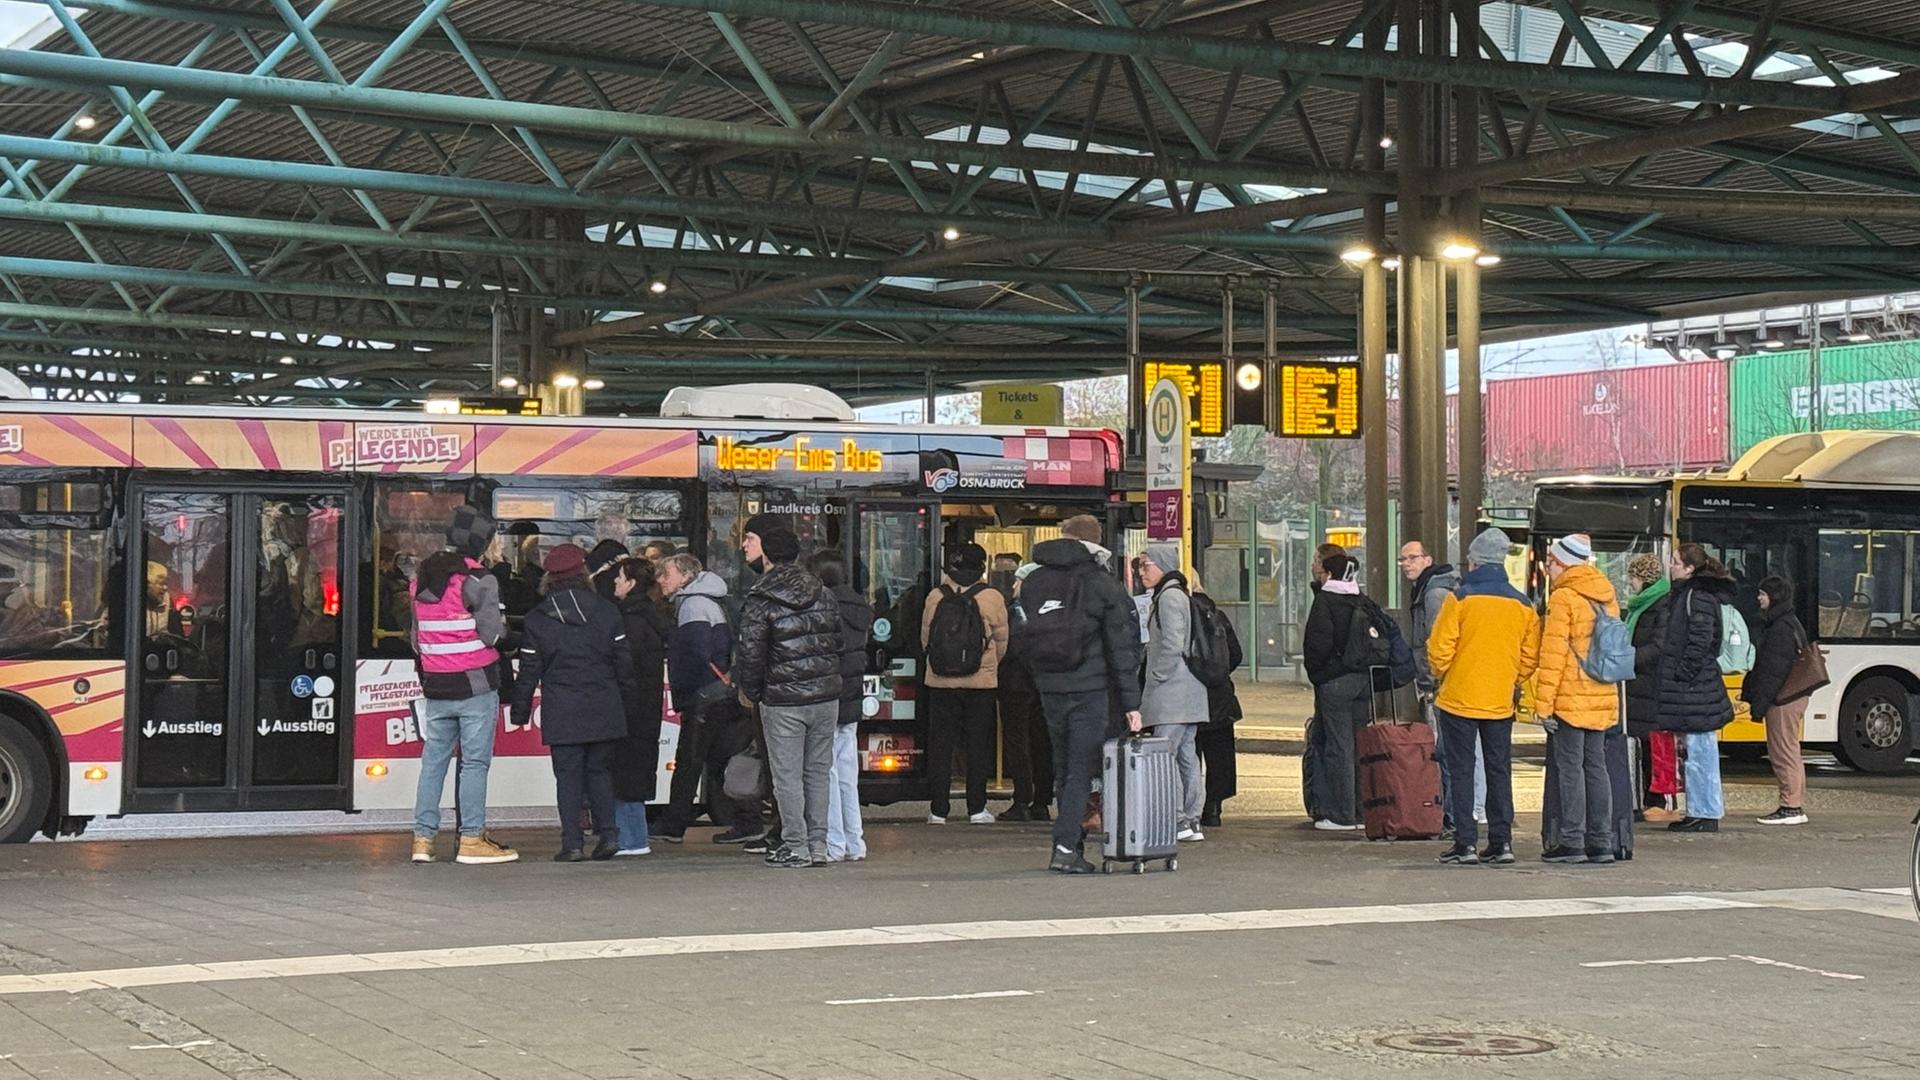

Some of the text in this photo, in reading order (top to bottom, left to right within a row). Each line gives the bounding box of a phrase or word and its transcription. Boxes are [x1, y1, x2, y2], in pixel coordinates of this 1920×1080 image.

[998, 391, 1039, 402] Tickets
[1013, 408, 1024, 420] &
[358, 428, 399, 441] WERDE
[716, 435, 883, 472] Weser-Ems Bus
[1033, 461, 1071, 471] MAN
[763, 502, 847, 515] Landkreis Osn
[1703, 498, 1730, 507] MAN
[158, 720, 222, 736] Ausstieg
[272, 719, 335, 735] Ausstieg
